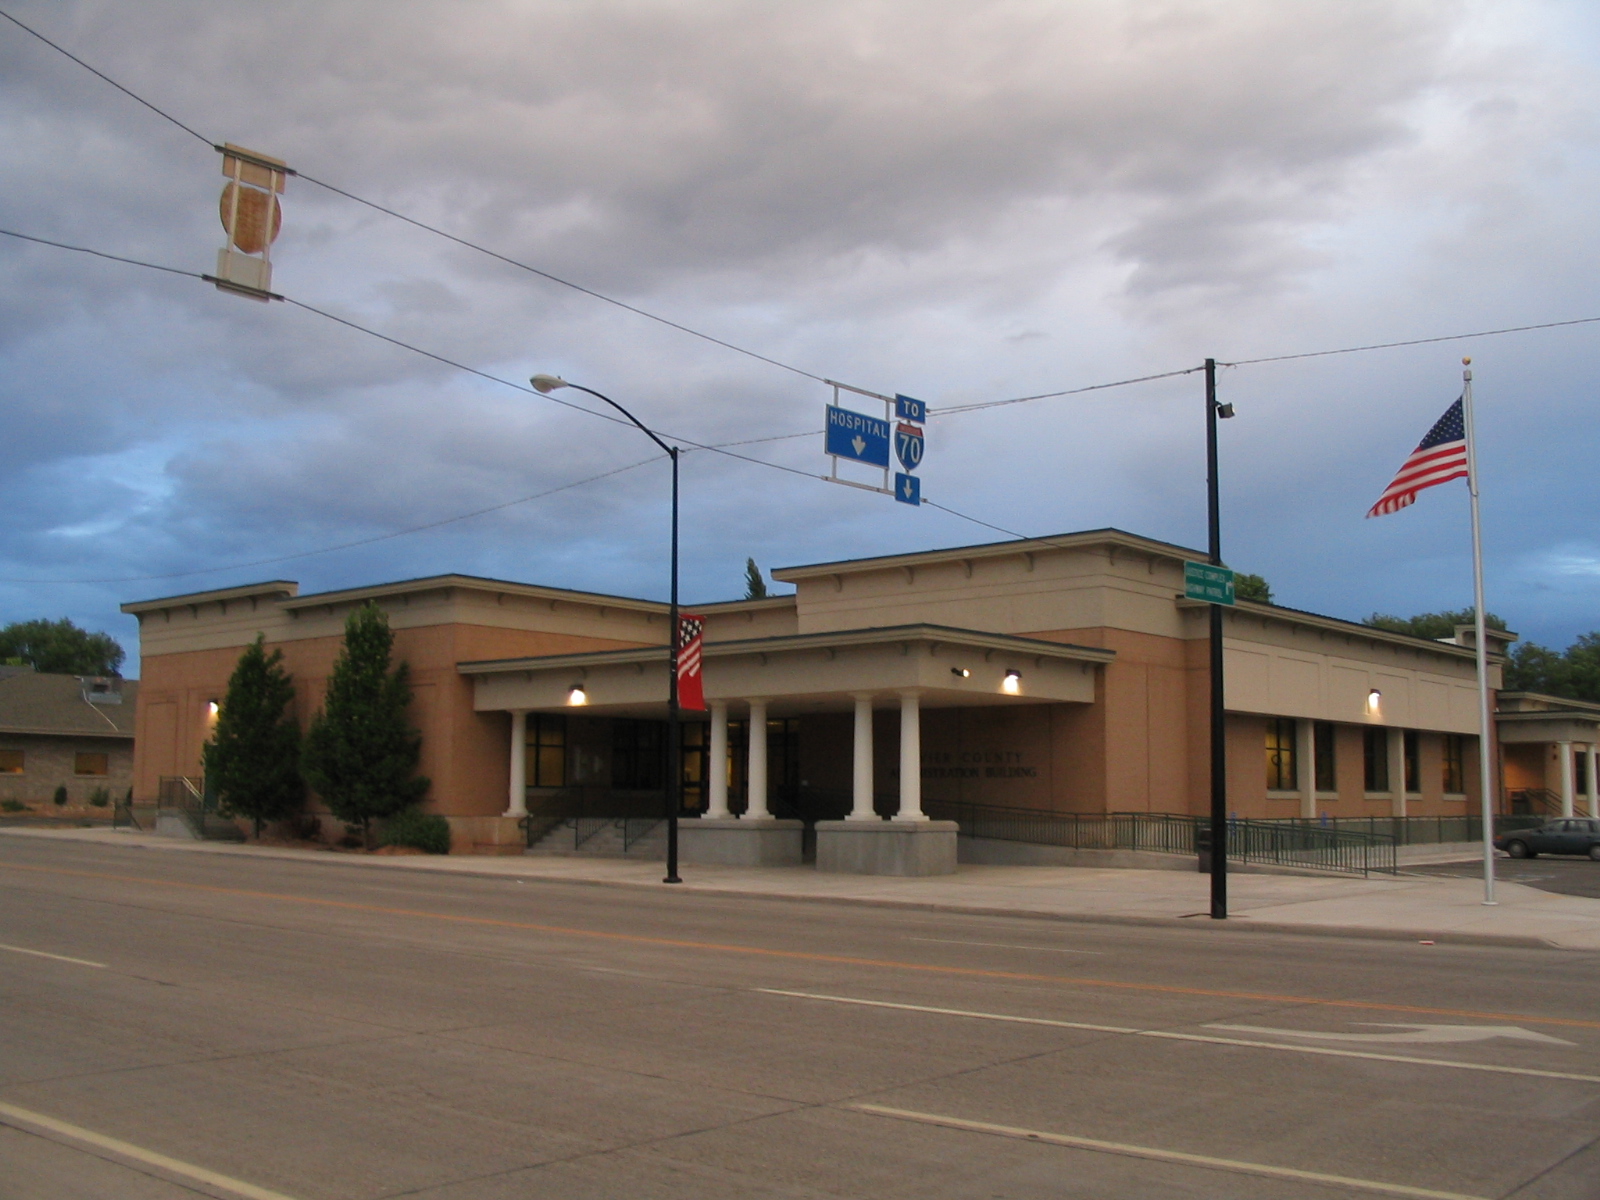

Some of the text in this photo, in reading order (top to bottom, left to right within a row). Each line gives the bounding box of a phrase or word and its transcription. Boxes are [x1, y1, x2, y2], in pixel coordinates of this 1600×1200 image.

[903, 400, 919, 417] TO
[829, 410, 888, 439] HOSPITAL
[900, 434, 920, 464] 70
[962, 752, 1022, 763] COUNTY
[985, 767, 1037, 778] BUILDING
